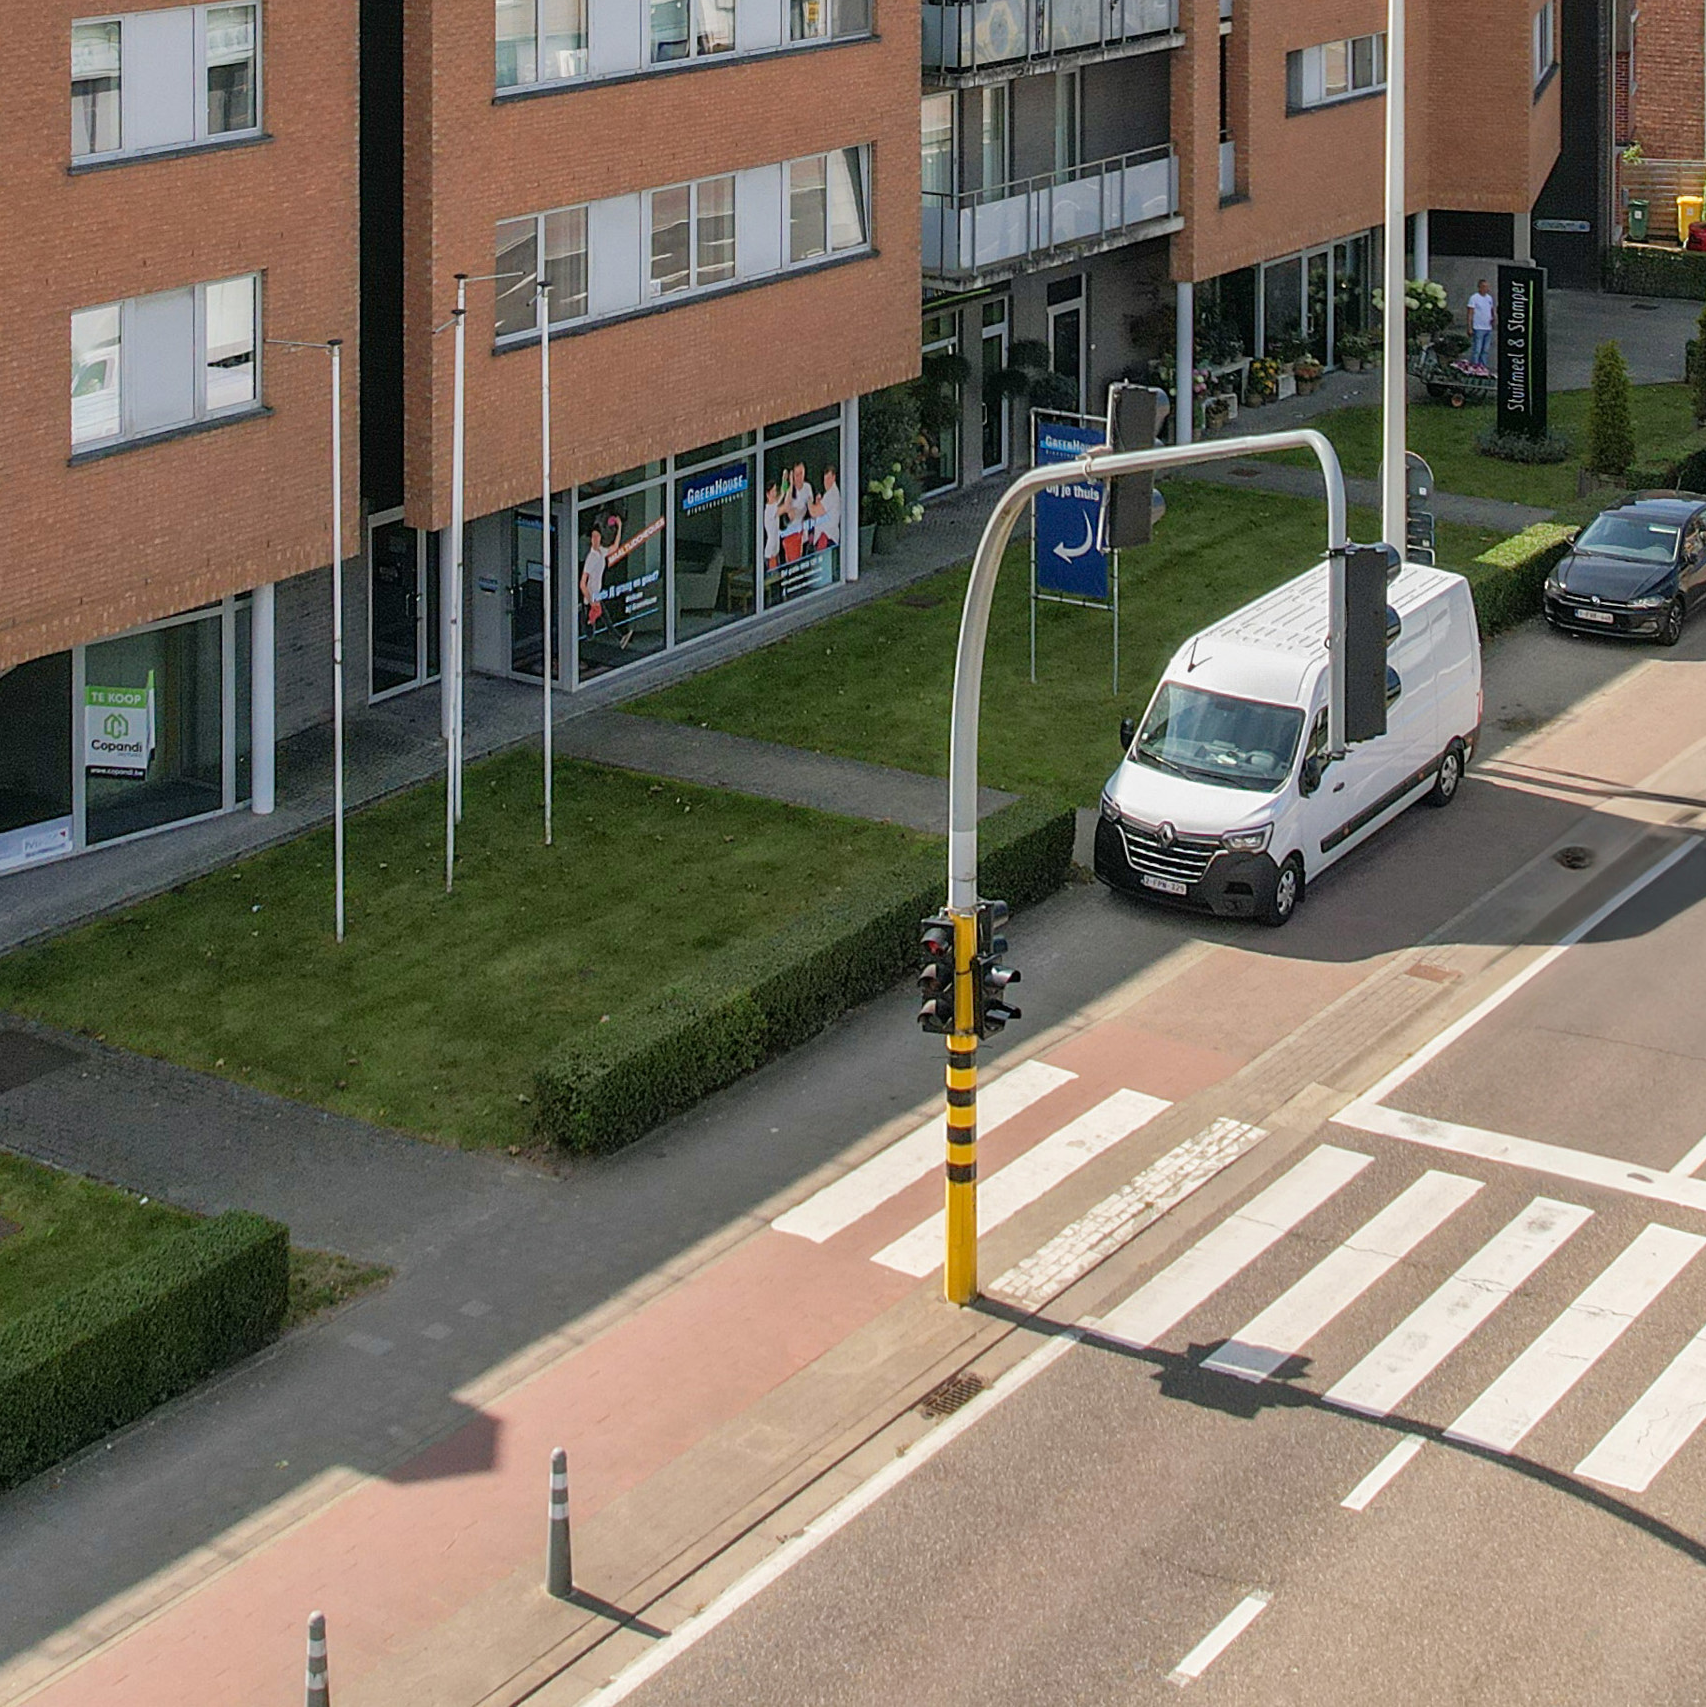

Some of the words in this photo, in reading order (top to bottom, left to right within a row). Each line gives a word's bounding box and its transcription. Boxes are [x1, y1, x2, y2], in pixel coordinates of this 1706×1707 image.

[1507, 338, 1526, 348] &
[1073, 485, 1100, 501] thuis
[91, 692, 105, 703] TE
[108, 693, 142, 704] KOOP
[91, 739, 143, 753] Copandi
